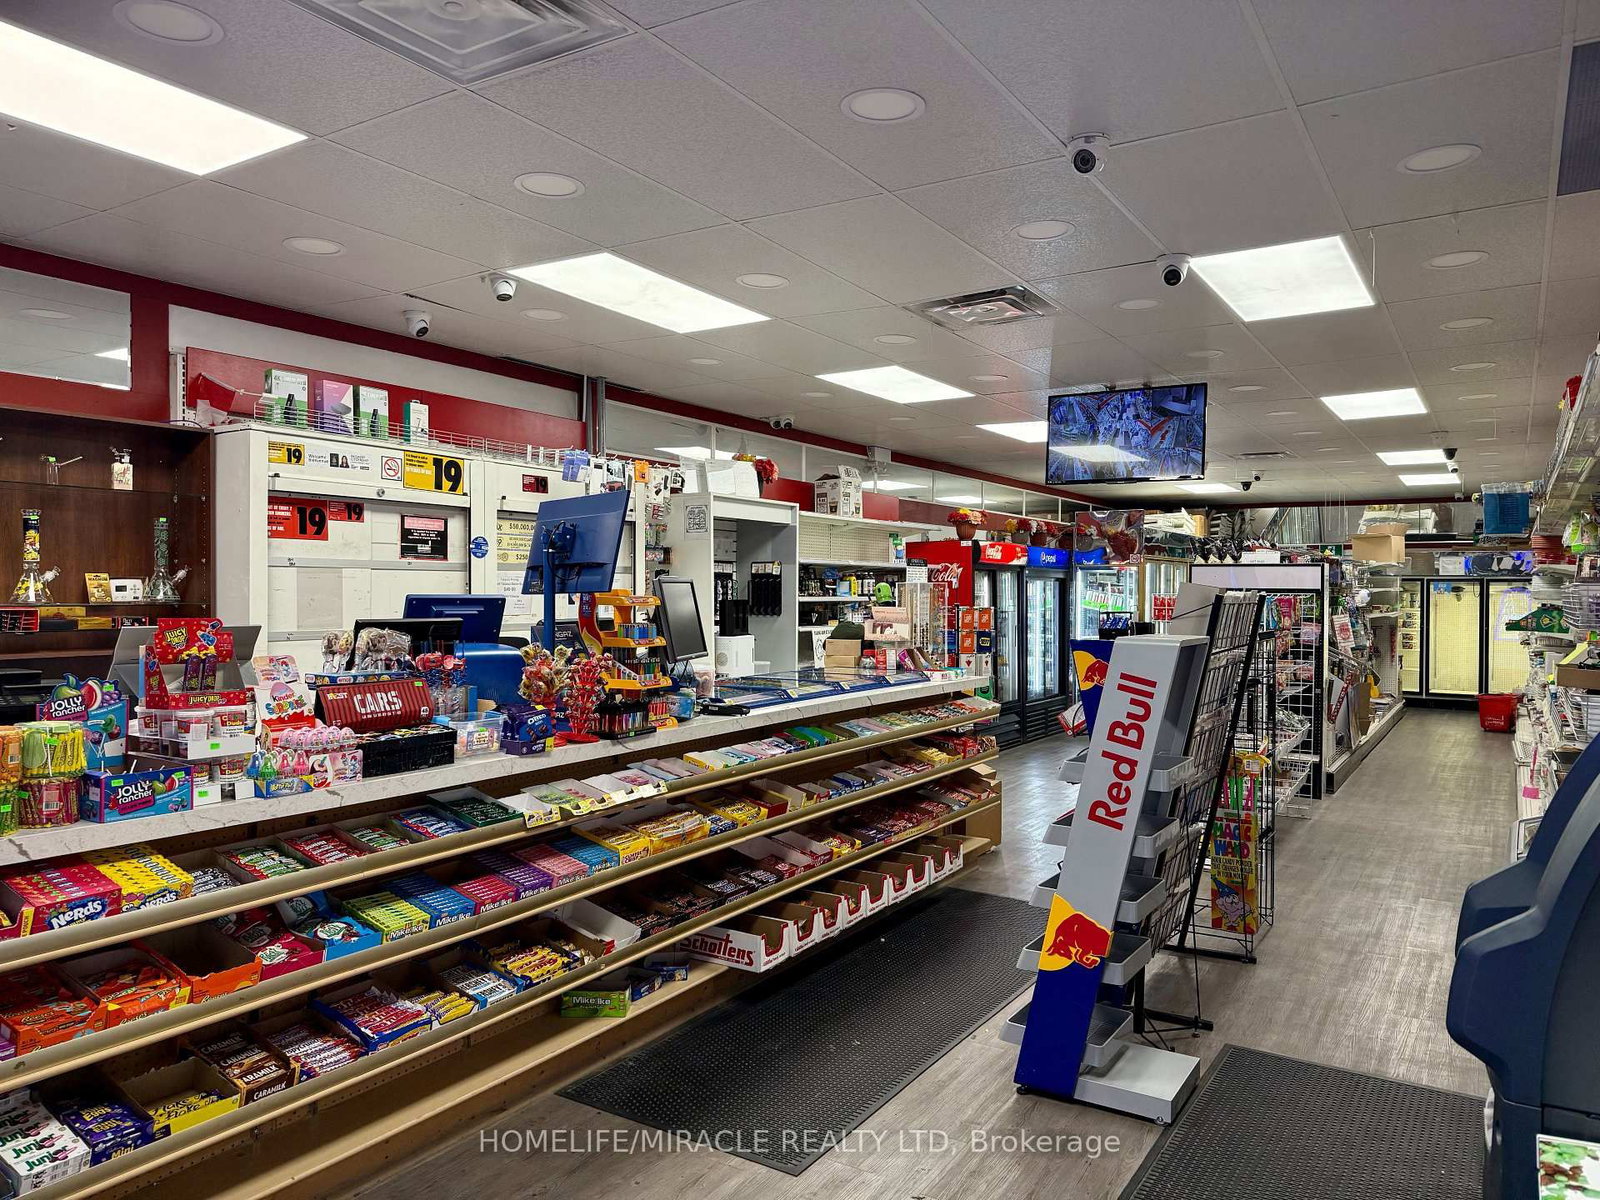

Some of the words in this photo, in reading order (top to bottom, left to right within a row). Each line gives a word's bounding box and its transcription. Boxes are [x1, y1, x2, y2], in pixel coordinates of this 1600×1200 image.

[286, 447, 302, 464] 19
[433, 457, 462, 492] 19
[296, 506, 326, 536] 19
[346, 503, 363, 521] 19
[166, 627, 187, 642] JUICY
[50, 694, 82, 713] JOLLY
[52, 703, 86, 719] rancher
[353, 690, 402, 714] CARS
[1107, 671, 1158, 751] Bull
[117, 780, 152, 799] JOLLY
[119, 789, 152, 805] rancher
[1087, 749, 1140, 832] Red
[519, 888, 539, 899] Mike
[539, 885, 550, 895] Ike
[480, 901, 500, 913] Mike
[499, 898, 512, 908] Ike
[436, 914, 458, 927] Mike
[458, 911, 471, 922] Ike
[389, 928, 410, 939] Mike
[410, 924, 424, 934] Ike
[572, 996, 595, 1004] Mike
[201, 1035, 243, 1054] CARAMILK
[220, 1047, 262, 1066] CARAMILK
[254, 1081, 286, 1100] CARAMILK
